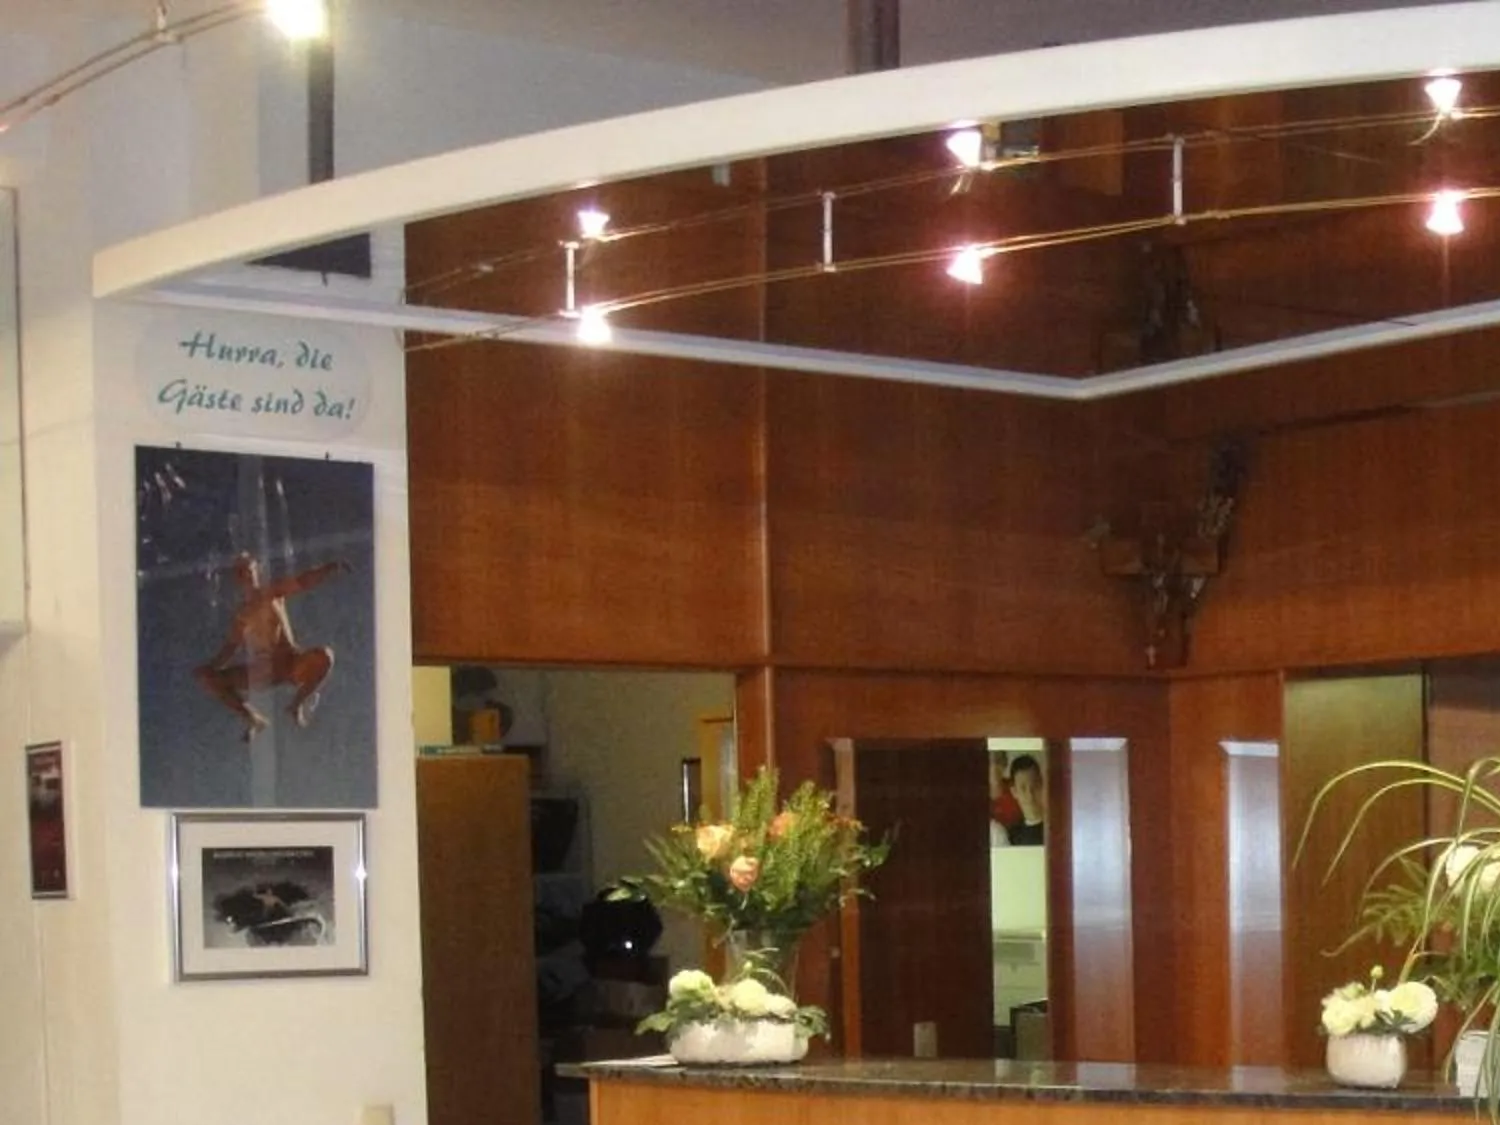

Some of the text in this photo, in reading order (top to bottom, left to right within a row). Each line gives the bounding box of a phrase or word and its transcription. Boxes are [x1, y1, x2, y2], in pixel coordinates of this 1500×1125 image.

[180, 329, 334, 371] Hurra, die
[157, 378, 356, 419] Gäste sind da!
